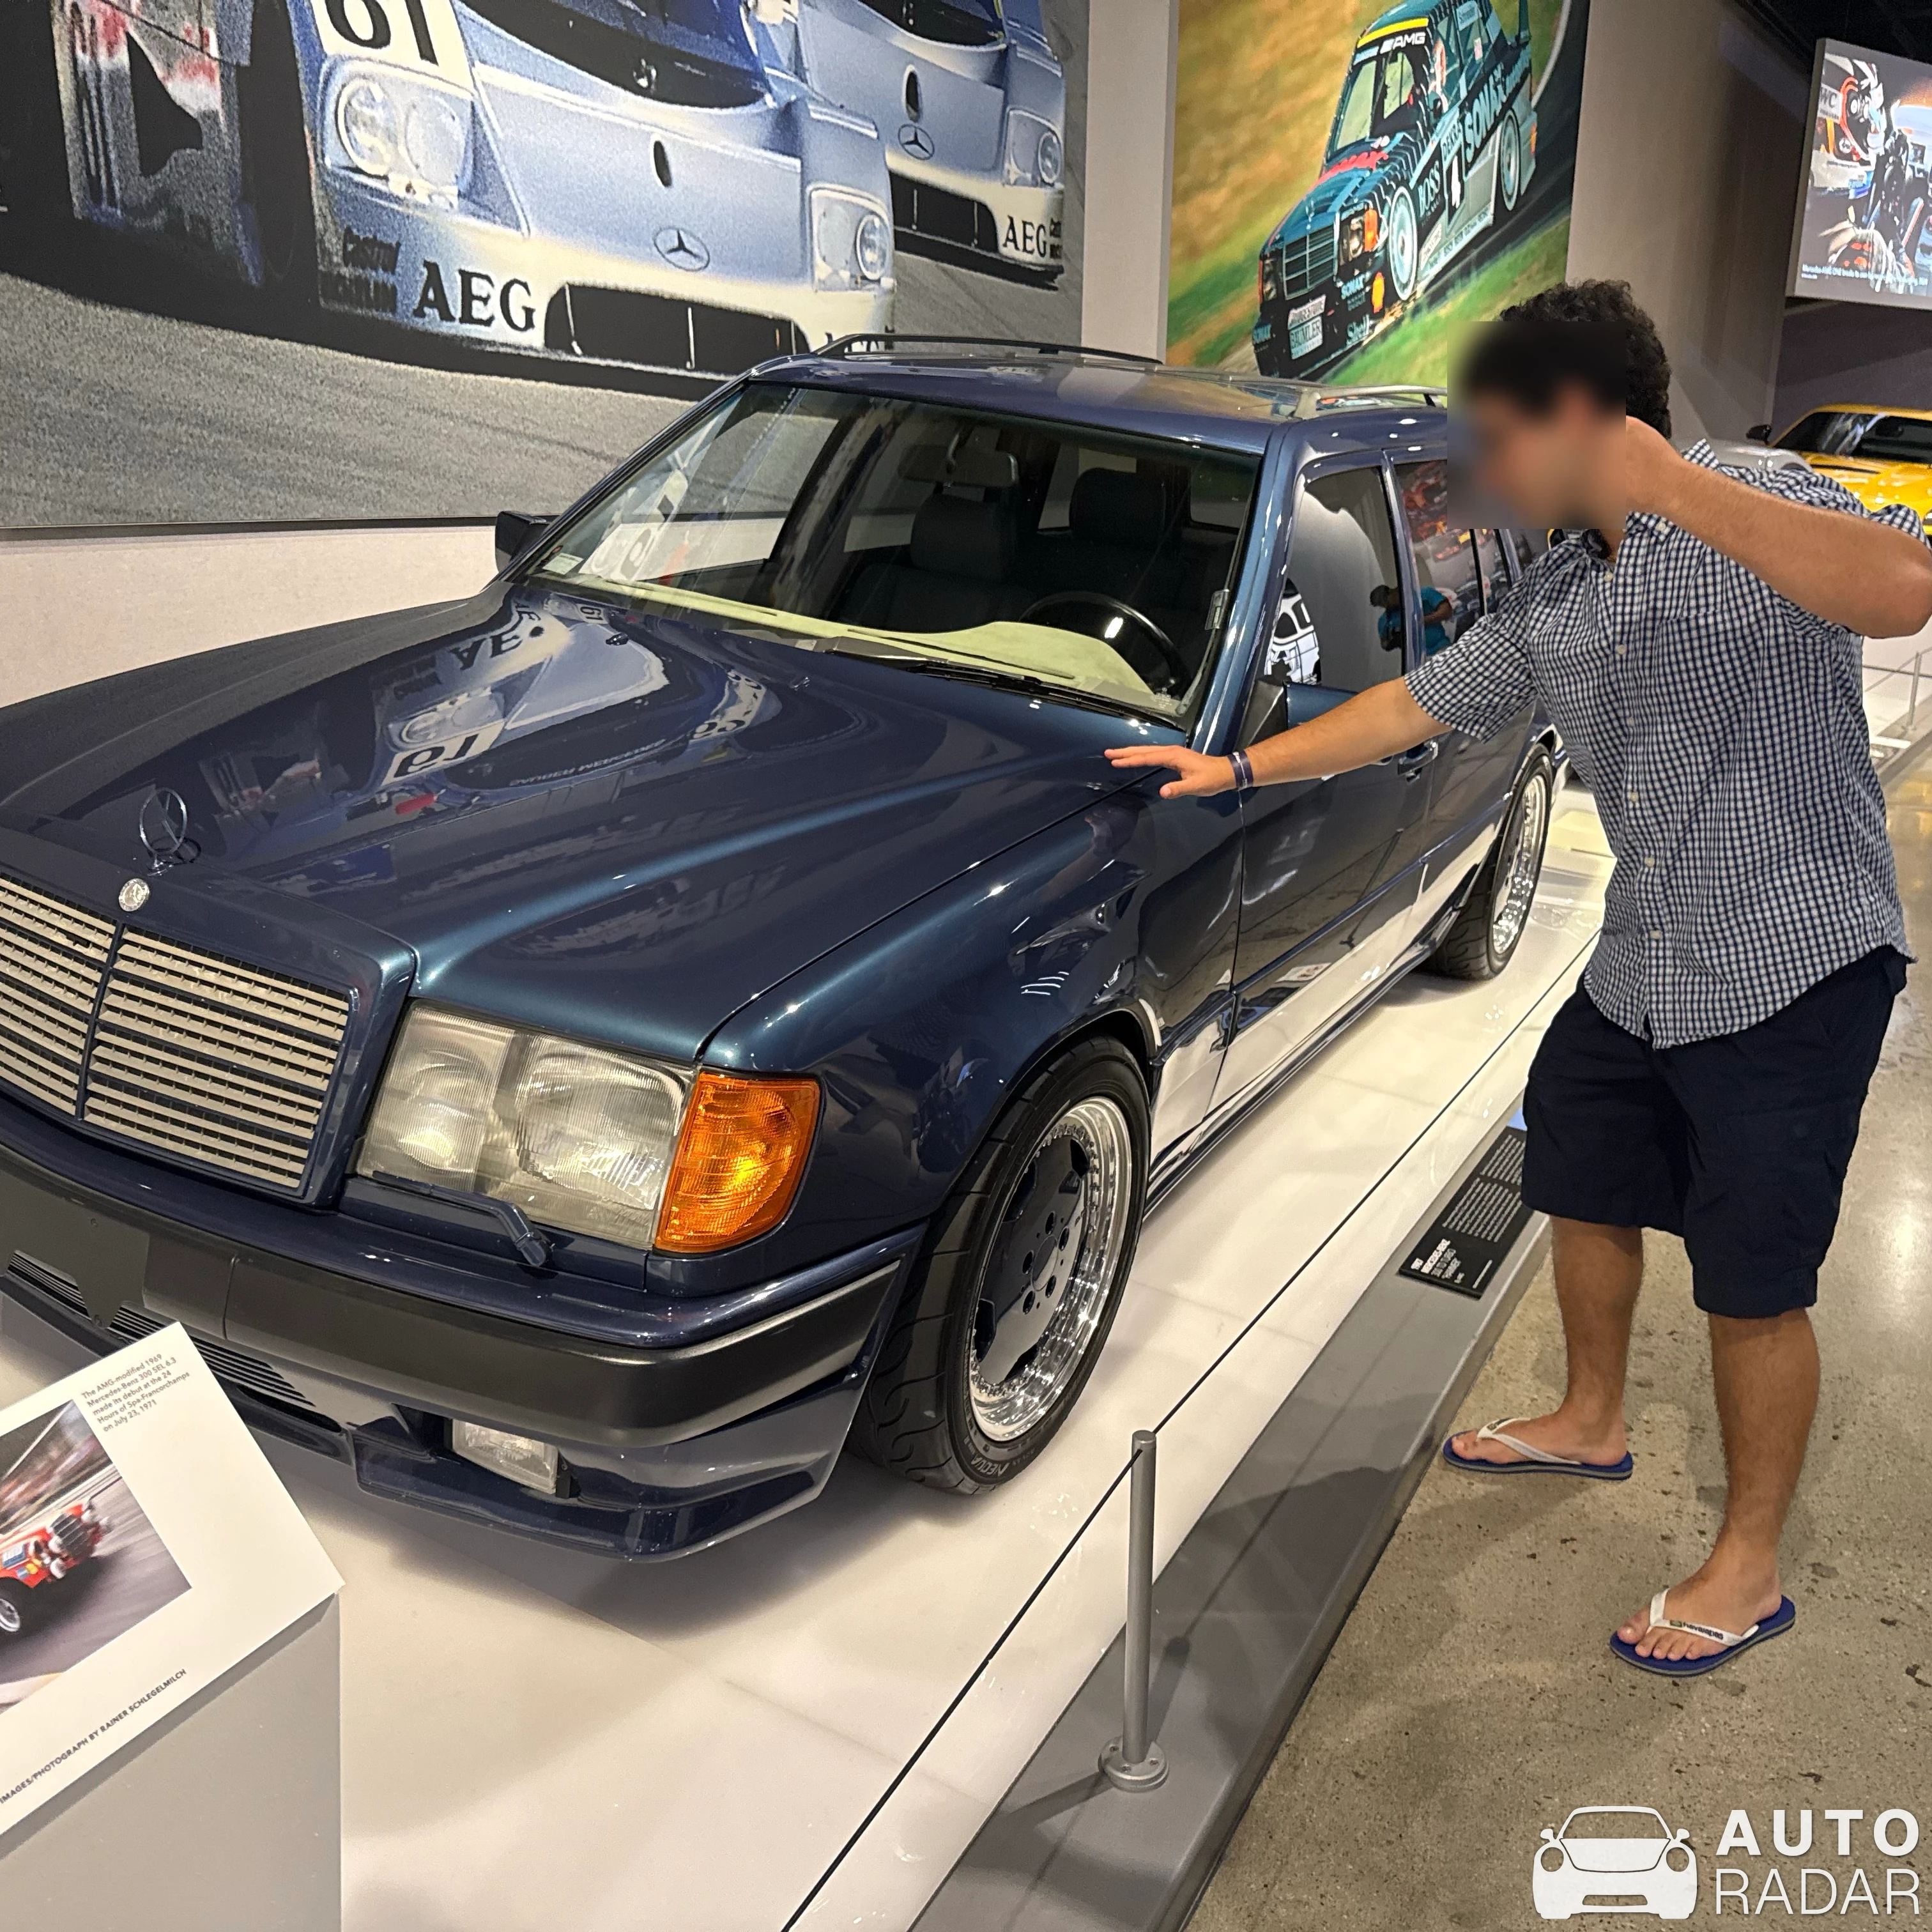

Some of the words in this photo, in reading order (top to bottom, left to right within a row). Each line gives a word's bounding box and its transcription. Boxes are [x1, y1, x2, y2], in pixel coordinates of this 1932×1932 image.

[1393, 32, 1426, 50] AMG
[1464, 62, 1506, 163] SONAX
[1418, 160, 1441, 218] BOSS
[1002, 215, 1047, 257] AEG
[413, 259, 536, 332] AEG
[1346, 313, 1370, 346] Shell
[81, 1389, 96, 1399] The
[96, 1362, 145, 1392] AMG-modified
[145, 1354, 162, 1367] 1969
[87, 1378, 139, 1407] Mercedes-Benz
[138, 1370, 153, 1381] 300
[151, 1363, 166, 1374] SEL
[165, 1357, 176, 1367] 6.3
[93, 1402, 113, 1416] made
[112, 1397, 122, 1405] its
[122, 1386, 143, 1400] debut
[143, 1381, 151, 1390] at
[150, 1376, 162, 1388] the
[162, 1370, 172, 1379] 24
[97, 1409, 119, 1424] Hours
[119, 1403, 128, 1413] of
[127, 1372, 190, 1409] Spa-Francorchamps
[103, 1423, 114, 1432] on
[114, 1414, 128, 1427] July
[127, 1409, 141, 1419] 23,
[139, 1399, 157, 1412] 1971
[0, 1737, 89, 1804] IMAGES/PHOTOGRAPH
[88, 1729, 100, 1741] BY
[99, 1710, 129, 1733] RAINER
[128, 1669, 187, 1713] SCHLEGELMILCH
